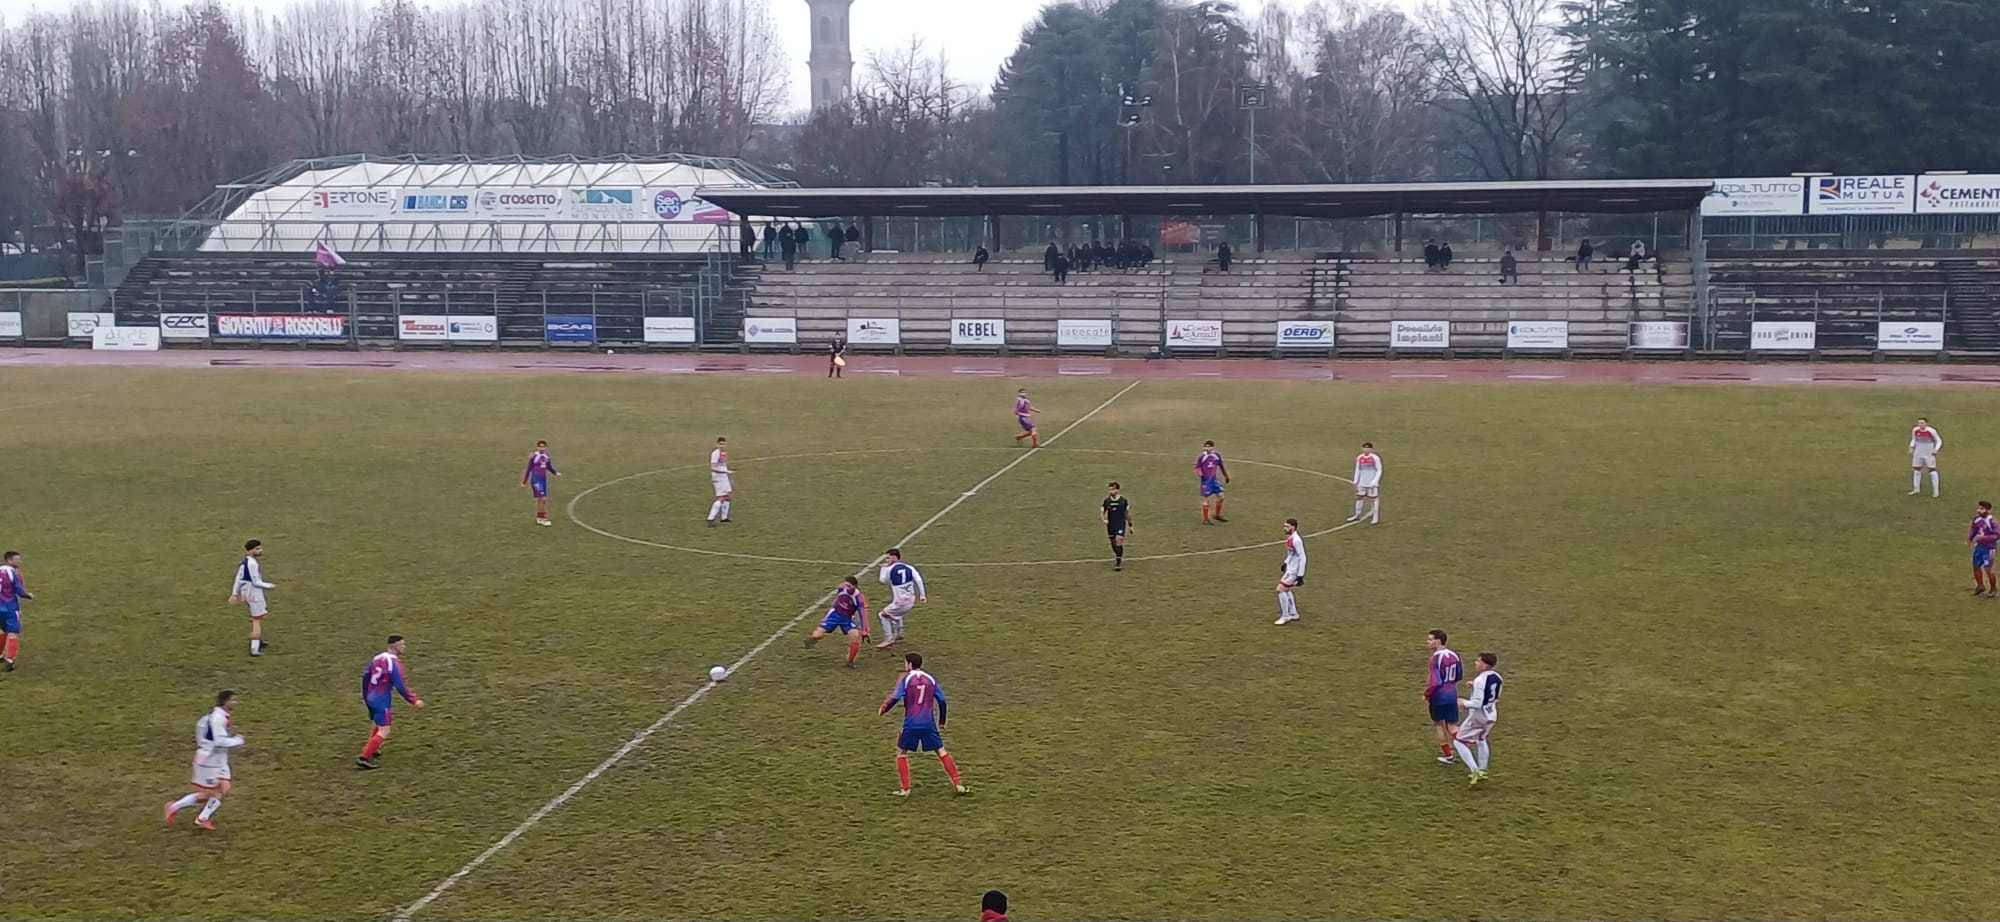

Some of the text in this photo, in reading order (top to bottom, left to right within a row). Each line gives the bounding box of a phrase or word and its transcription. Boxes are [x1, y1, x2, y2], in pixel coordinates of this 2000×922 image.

[1843, 178, 1905, 189] REALE
[1843, 191, 1905, 199] MUTUA
[959, 322, 997, 337] REBEL
[1283, 327, 1327, 337] DERBY
[897, 568, 907, 584] 7
[1444, 663, 1457, 683] 10
[916, 684, 926, 705] 7
